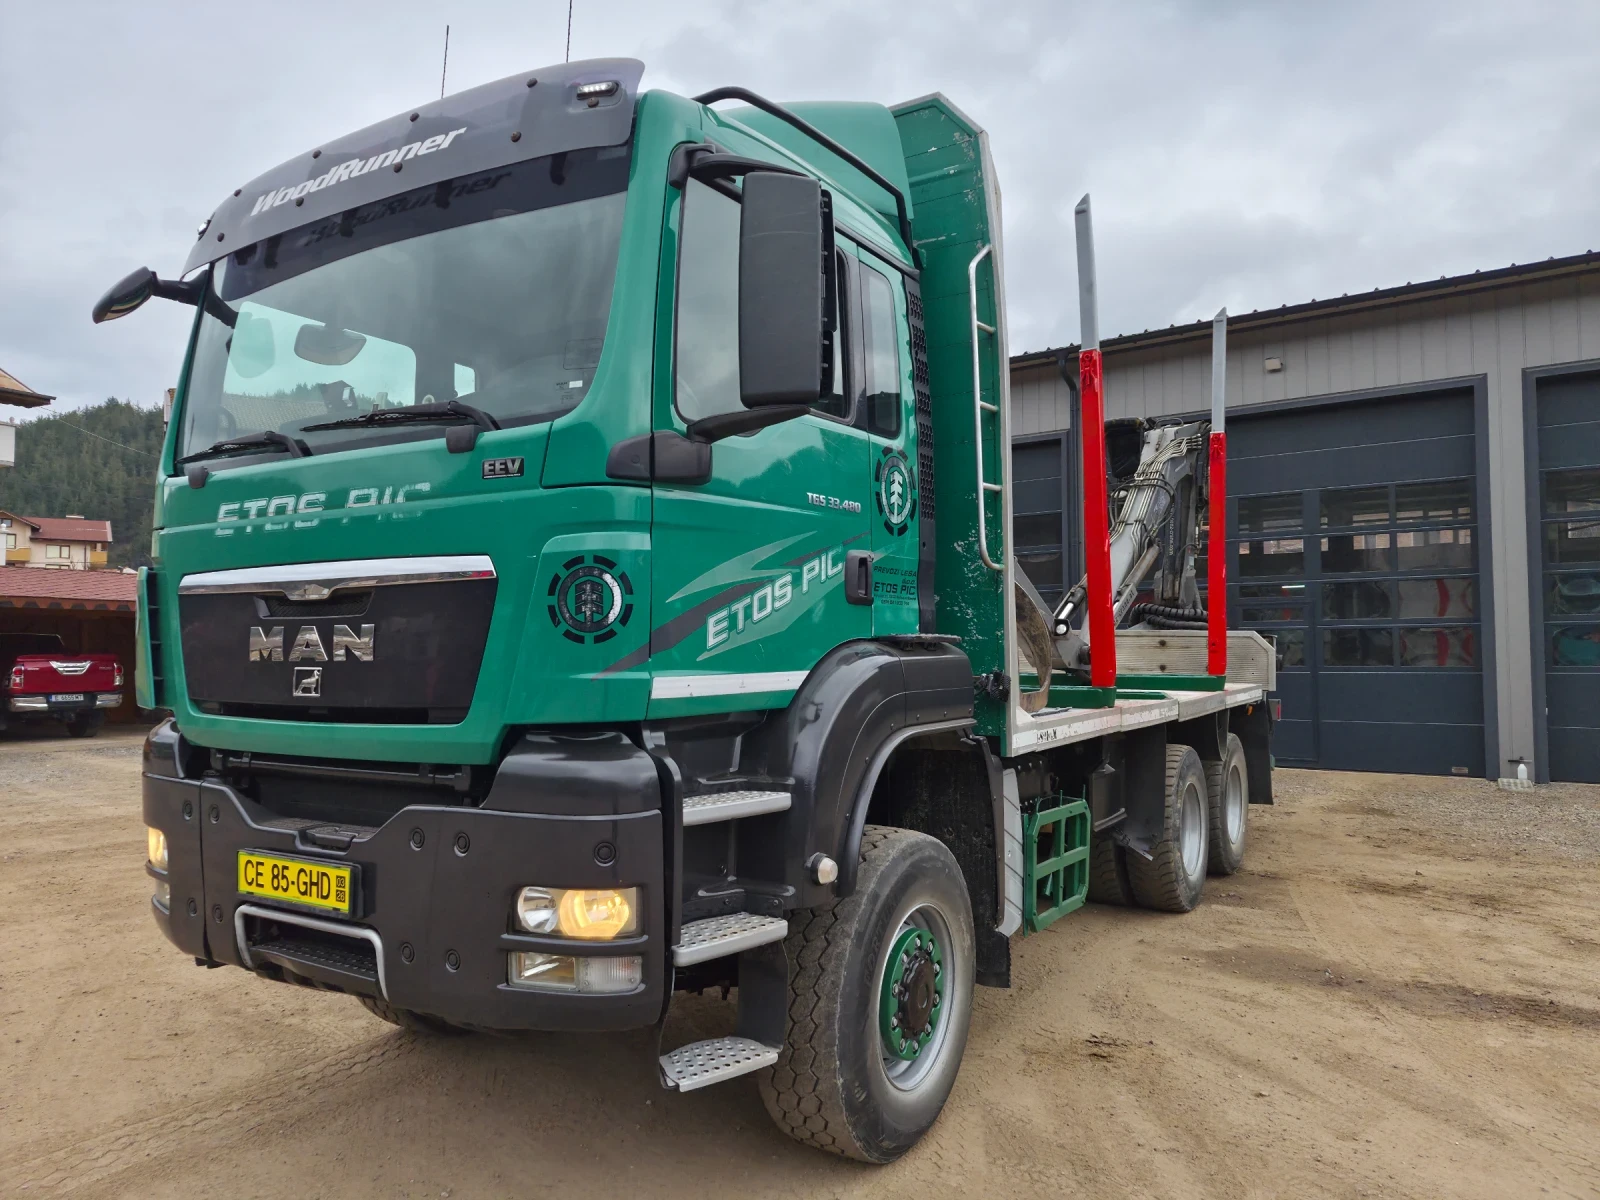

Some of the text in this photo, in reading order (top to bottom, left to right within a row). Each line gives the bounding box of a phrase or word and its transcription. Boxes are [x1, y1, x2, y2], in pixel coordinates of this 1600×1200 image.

[250, 127, 467, 216] WoodRunner
[483, 458, 522, 475] EEV
[214, 491, 327, 537] ETOS
[806, 492, 862, 513] TGS 33.480
[707, 545, 843, 650] ETOS PIC
[873, 582, 916, 596] ETOS PIC
[249, 624, 375, 662] MAN
[244, 859, 331, 900] CE 85-GHD
[336, 877, 345, 887] 03
